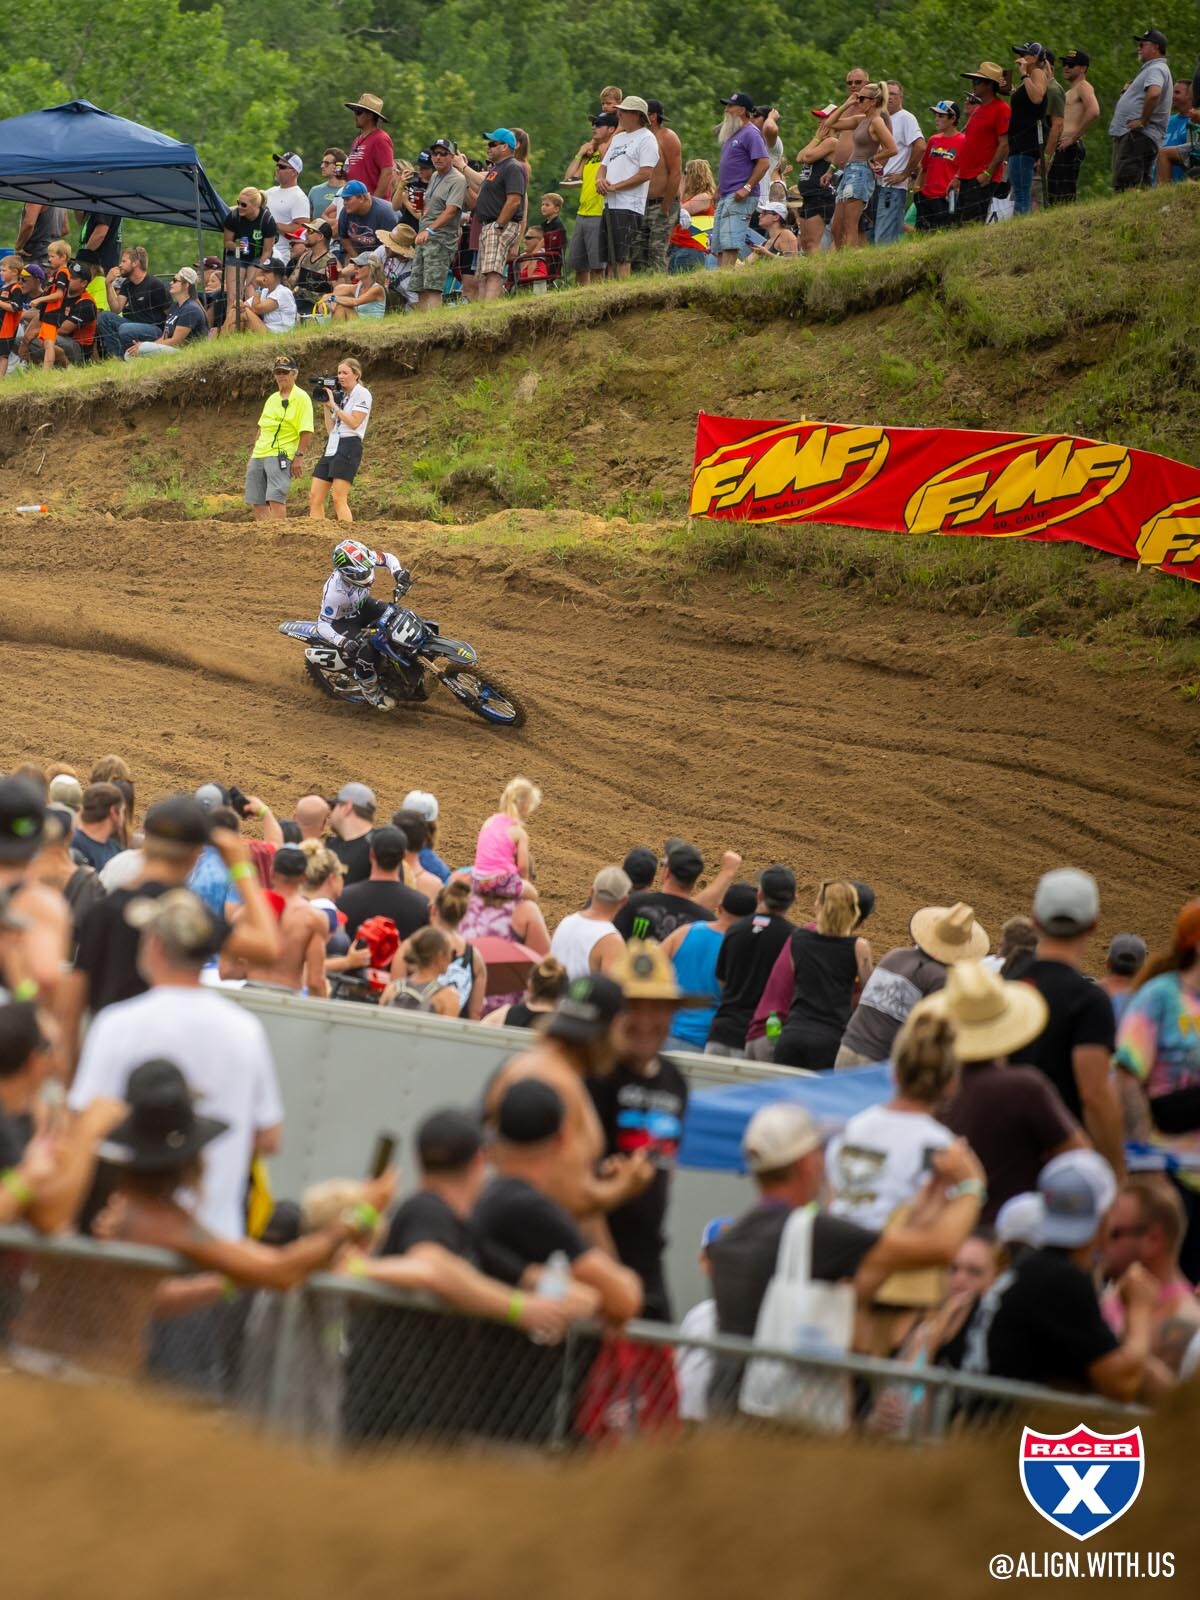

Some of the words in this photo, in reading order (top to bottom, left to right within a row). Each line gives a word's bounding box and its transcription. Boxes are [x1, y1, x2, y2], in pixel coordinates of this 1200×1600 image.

[691, 427, 884, 516] FMF
[907, 440, 1128, 534] FMF
[396, 613, 421, 645] 3
[314, 650, 337, 669] 3
